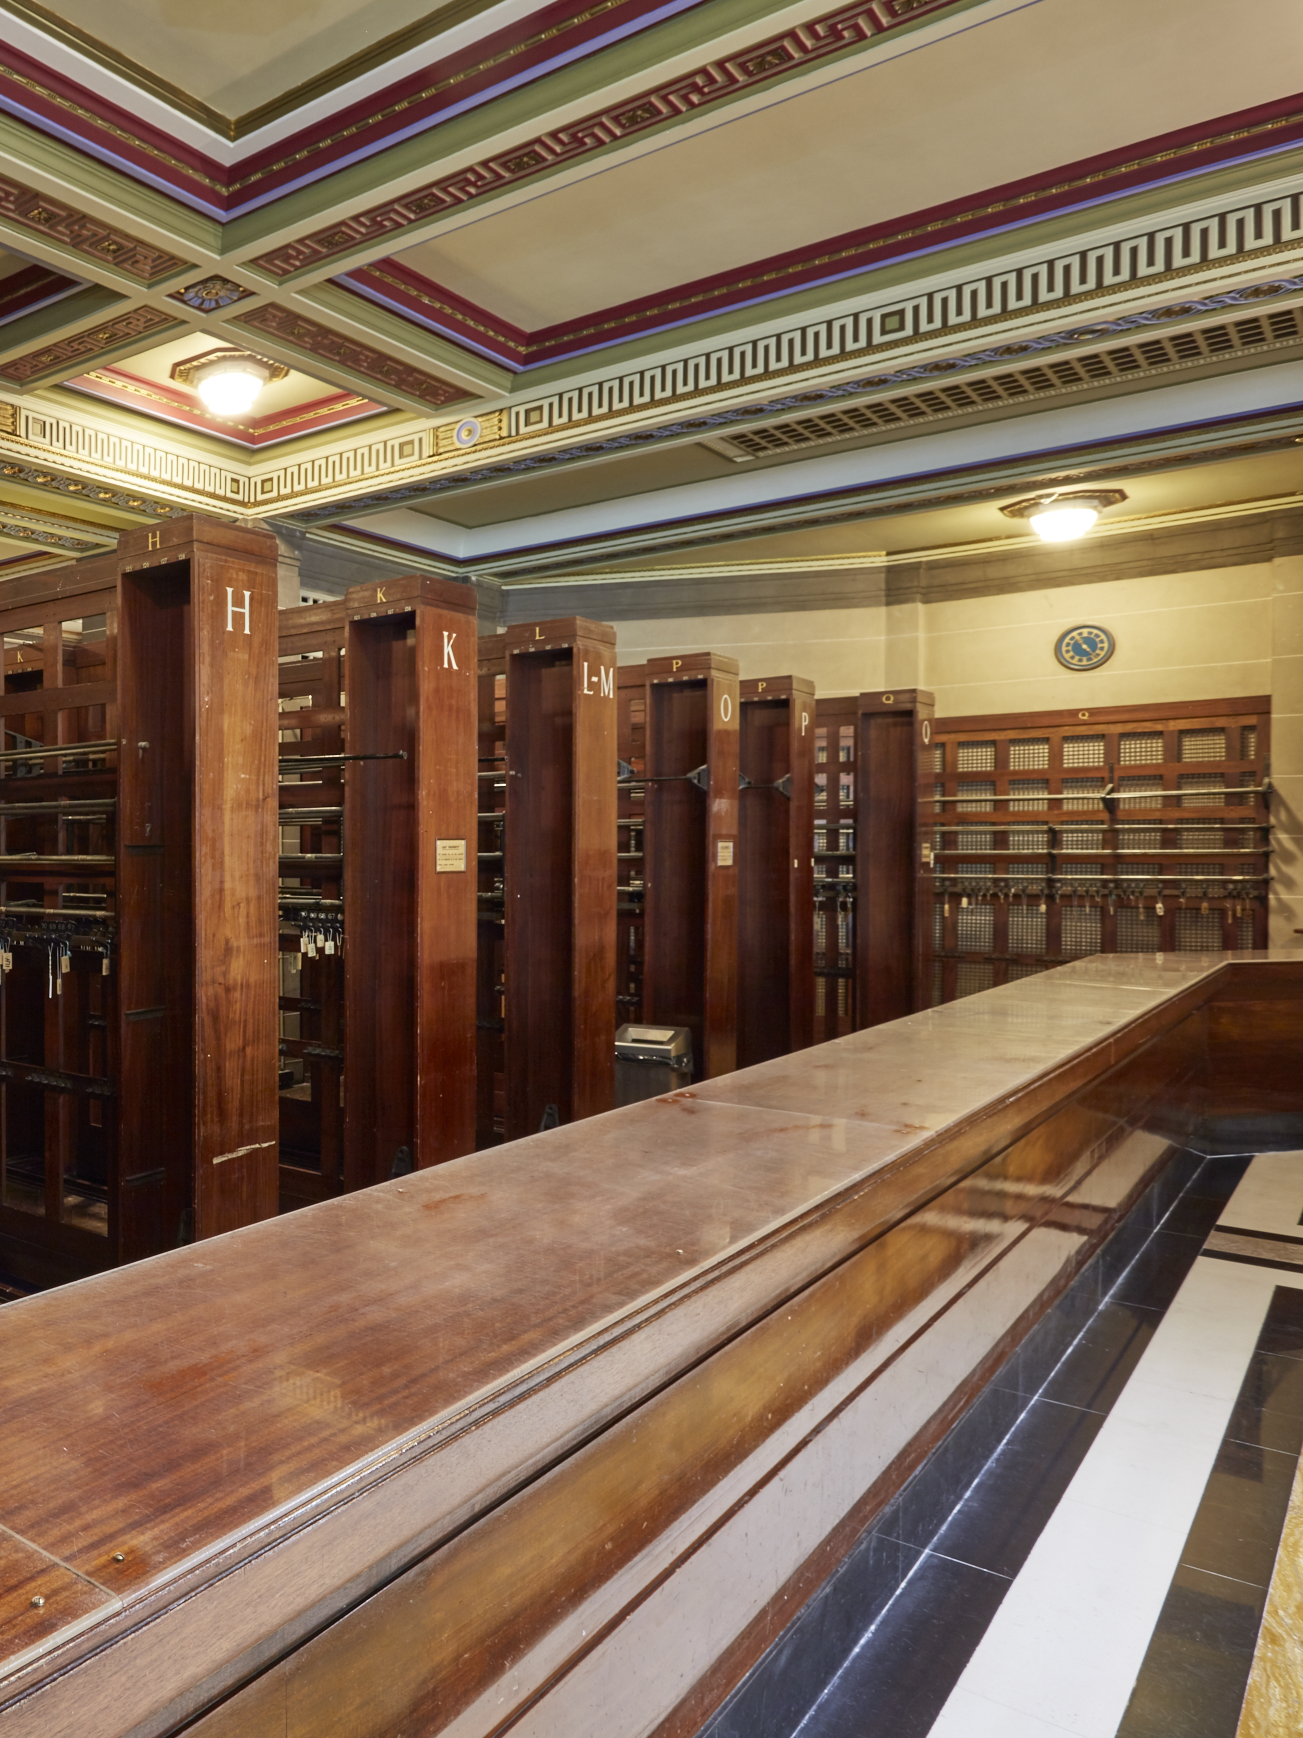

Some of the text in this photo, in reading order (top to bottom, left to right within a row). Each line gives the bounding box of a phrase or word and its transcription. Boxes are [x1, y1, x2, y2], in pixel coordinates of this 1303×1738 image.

[148, 530, 161, 551] H
[376, 586, 387, 603] K
[225, 586, 252, 635] H
[535, 626, 546, 640] L
[17, 650, 24, 663] K
[442, 630, 458, 670] K
[672, 659, 682, 672] P
[583, 661, 614, 699] L-M
[758, 681, 767, 692] P
[720, 694, 732, 722] O
[882, 694, 894, 704] Q
[801, 712, 809, 736] P
[1078, 711, 1090, 720] Q
[922, 720, 930, 745] Q
